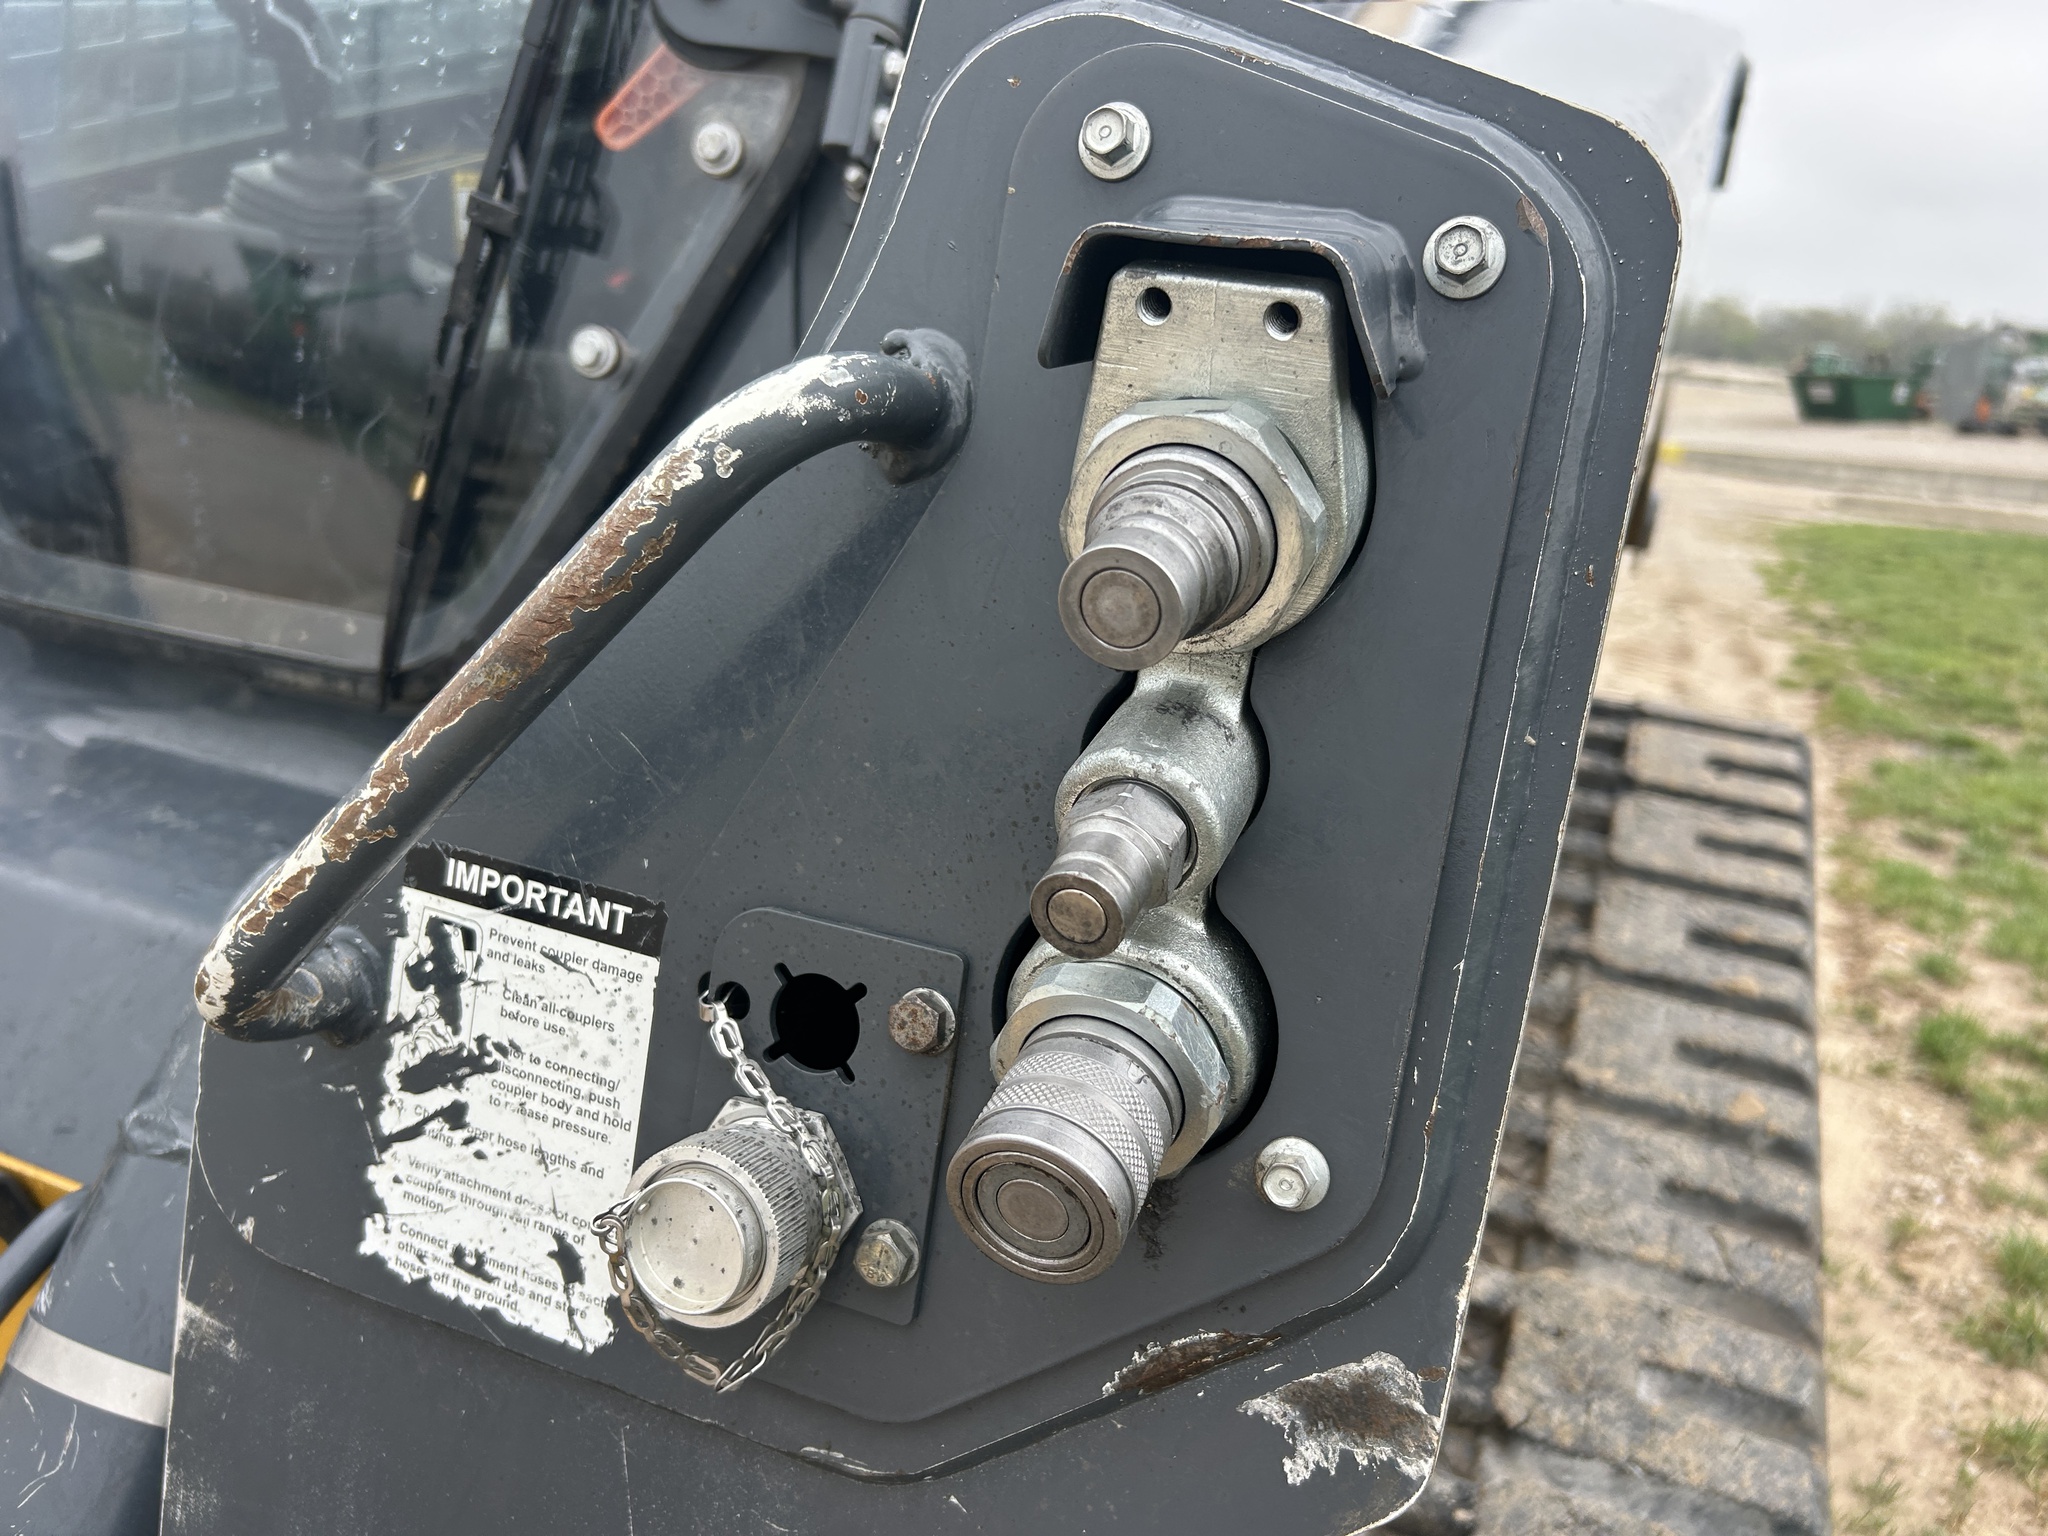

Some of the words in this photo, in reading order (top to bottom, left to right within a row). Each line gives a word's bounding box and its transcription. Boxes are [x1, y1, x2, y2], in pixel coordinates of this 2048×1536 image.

[446, 857, 633, 935] IMPORTANT
[487, 948, 510, 964] and
[513, 954, 545, 974] leaks
[489, 928, 537, 953] Prevent
[540, 945, 589, 967] coupler
[592, 956, 643, 983] damage
[500, 1005, 540, 1028] before
[543, 1021, 569, 1037] use.
[503, 988, 537, 1009] Clean
[541, 1001, 556, 1014] all
[560, 1008, 615, 1033] couplers
[529, 1053, 541, 1065] to
[545, 1059, 621, 1092] connecting/
[489, 1094, 501, 1107] to
[552, 1117, 611, 1145] pressure.
[491, 1078, 539, 1101] coupler
[542, 1092, 573, 1115] body
[575, 1105, 600, 1122] and
[603, 1113, 632, 1132] hold
[589, 1091, 621, 1110] push
[498, 1134, 527, 1152] hose
[531, 1143, 577, 1170] lengths
[580, 1162, 605, 1180] and
[443, 1168, 511, 1202] attachment
[405, 1174, 457, 1199] couplers
[573, 1234, 585, 1246] of
[400, 1222, 448, 1250] Connect
[395, 1256, 429, 1275] hoses
[434, 1272, 449, 1286] off
[452, 1278, 470, 1293] the
[474, 1288, 520, 1312] ground.
[504, 1281, 525, 1295] use
[529, 1289, 552, 1306] and
[555, 1300, 587, 1319] stre
